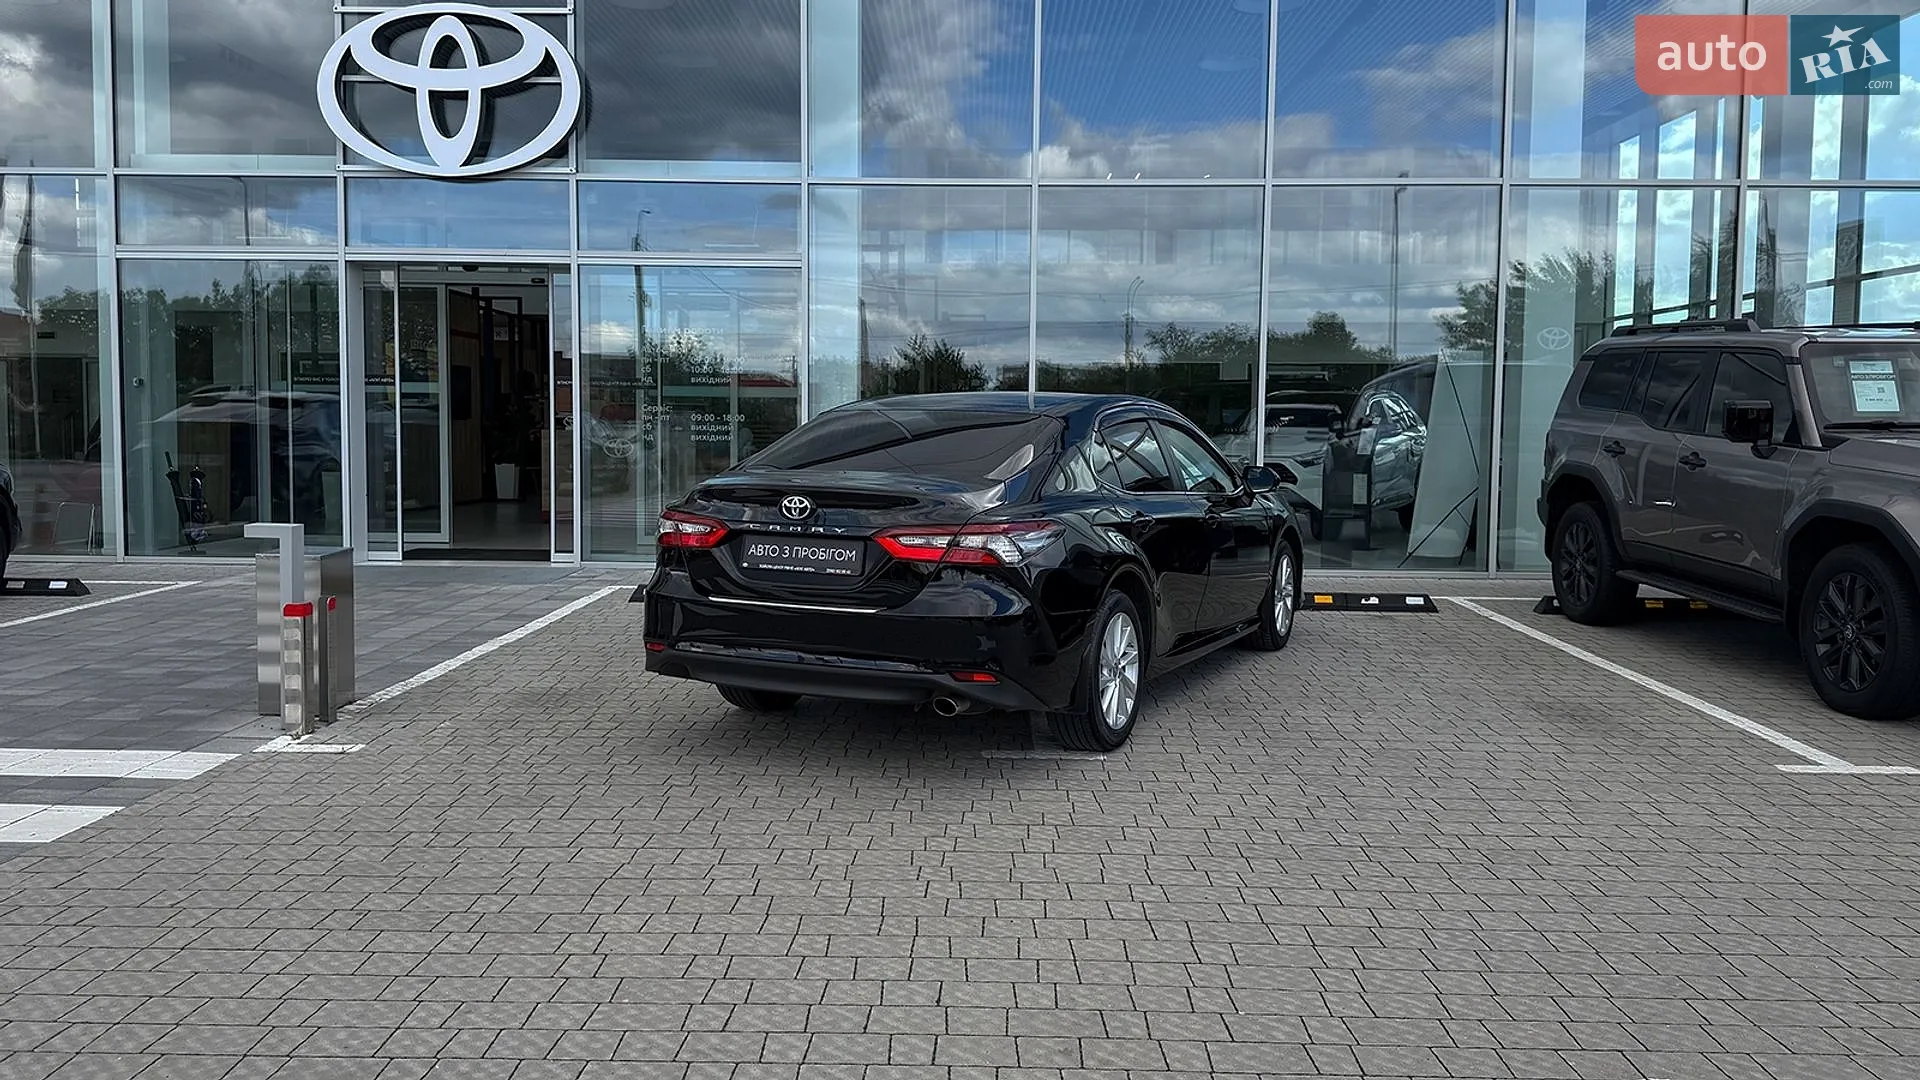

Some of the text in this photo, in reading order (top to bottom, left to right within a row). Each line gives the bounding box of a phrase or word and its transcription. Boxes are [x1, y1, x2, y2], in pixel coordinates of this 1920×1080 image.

[690, 366, 713, 374] 10:00
[690, 376, 732, 384] вихідний
[690, 413, 715, 421] 09:00
[723, 413, 745, 422] 18:00
[690, 423, 734, 432] вихідний
[690, 433, 734, 442] вихідний
[749, 523, 847, 534] CAMRY
[748, 544, 856, 561] АВТО З ПРОБІГОМ
